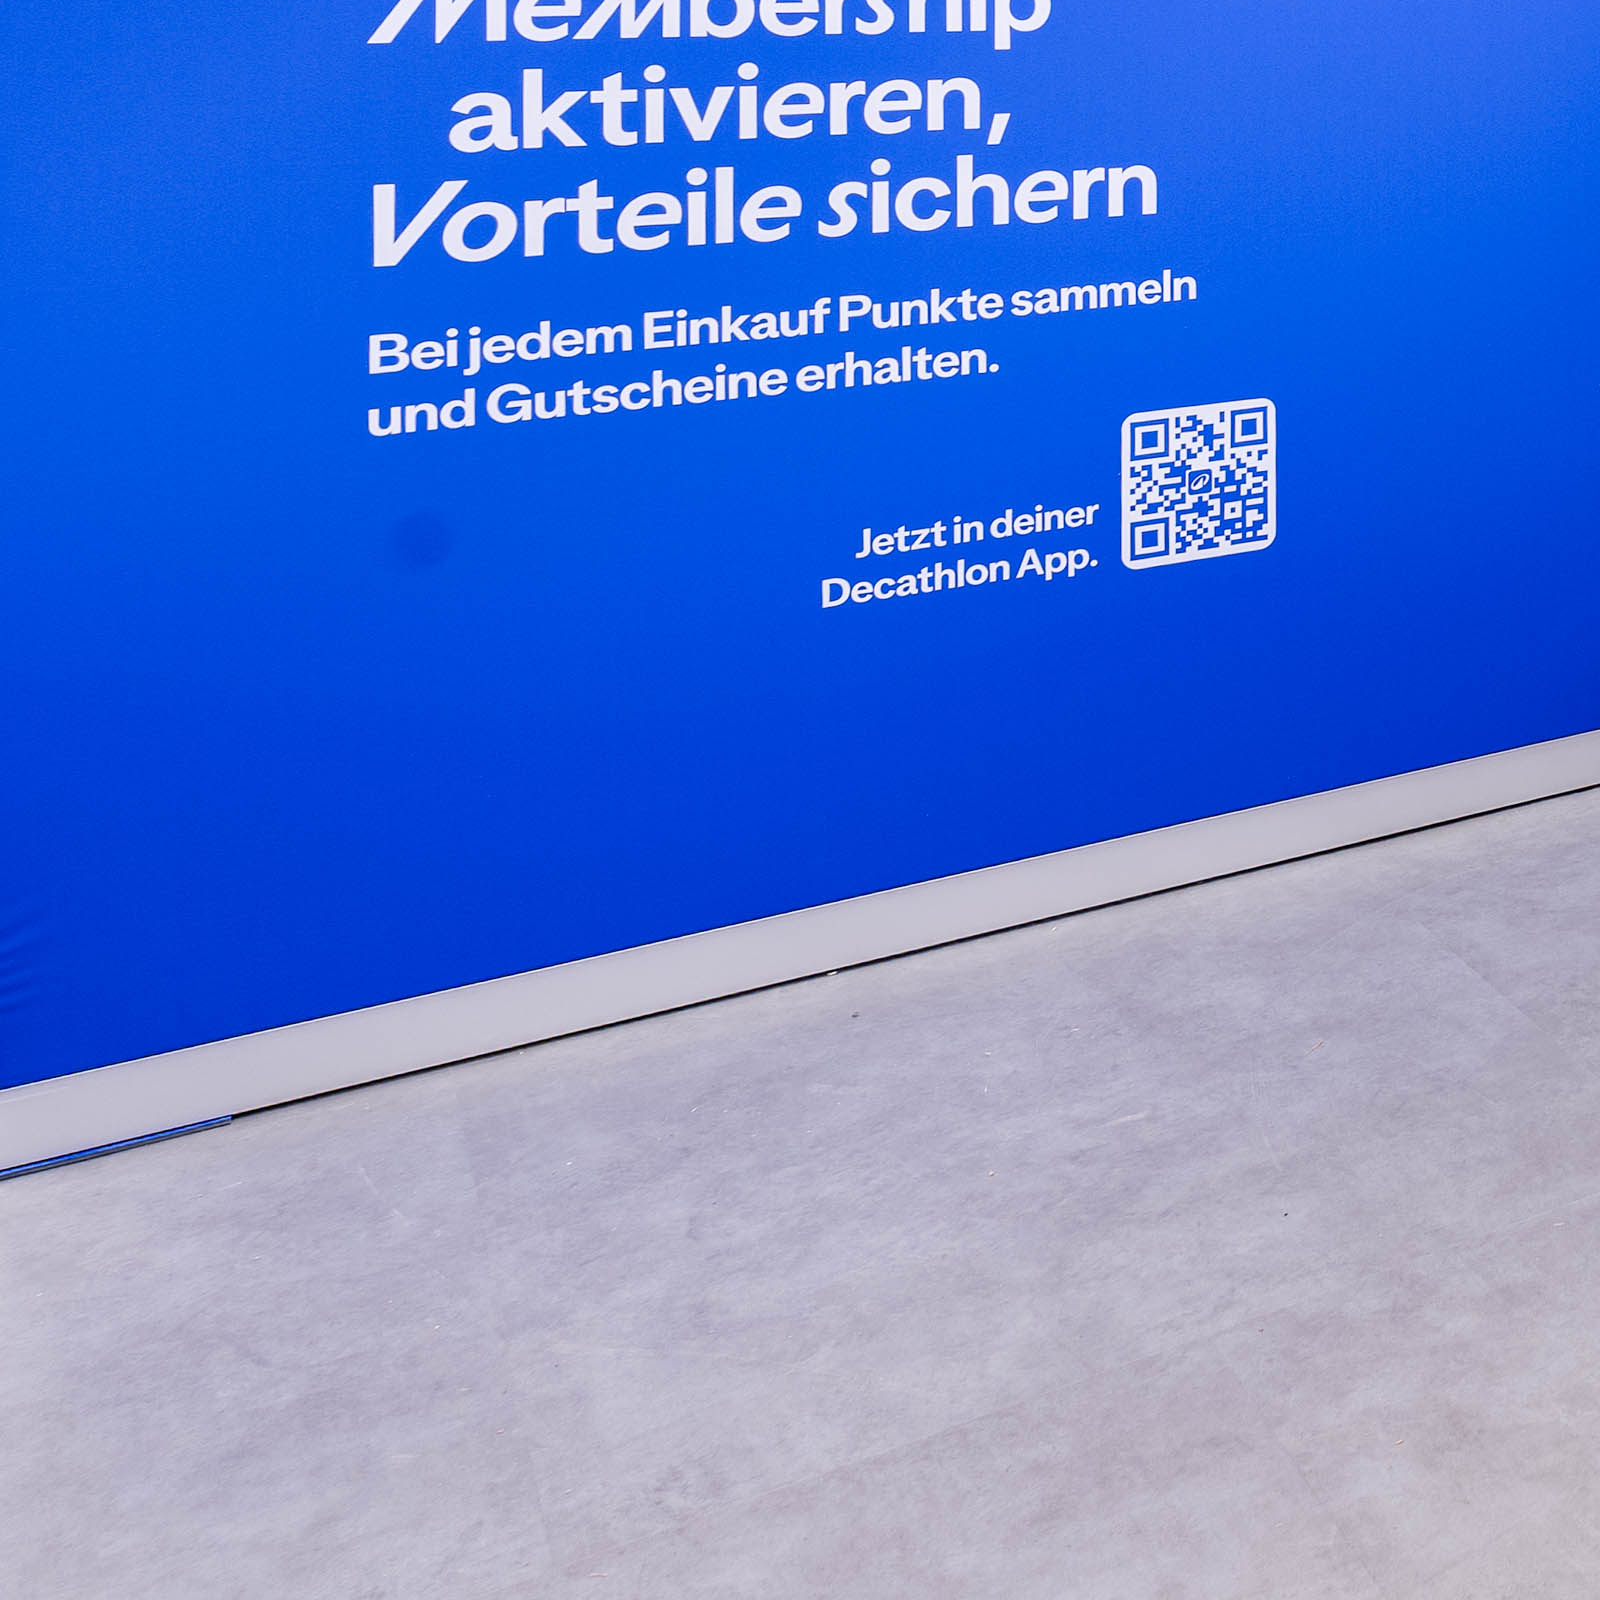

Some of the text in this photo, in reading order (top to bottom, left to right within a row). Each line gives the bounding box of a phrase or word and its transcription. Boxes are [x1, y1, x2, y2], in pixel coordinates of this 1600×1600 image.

[448, 62, 1011, 153] aktivieren,
[372, 154, 1158, 267] Vorteile sichern
[368, 268, 1198, 376] Bei jedem Einkauf Punkte sammeln
[368, 345, 1000, 437] und Gutscheine erhalten.
[855, 504, 1100, 559] Jetzt in deiner
[821, 548, 1099, 609] Decathlon App.
